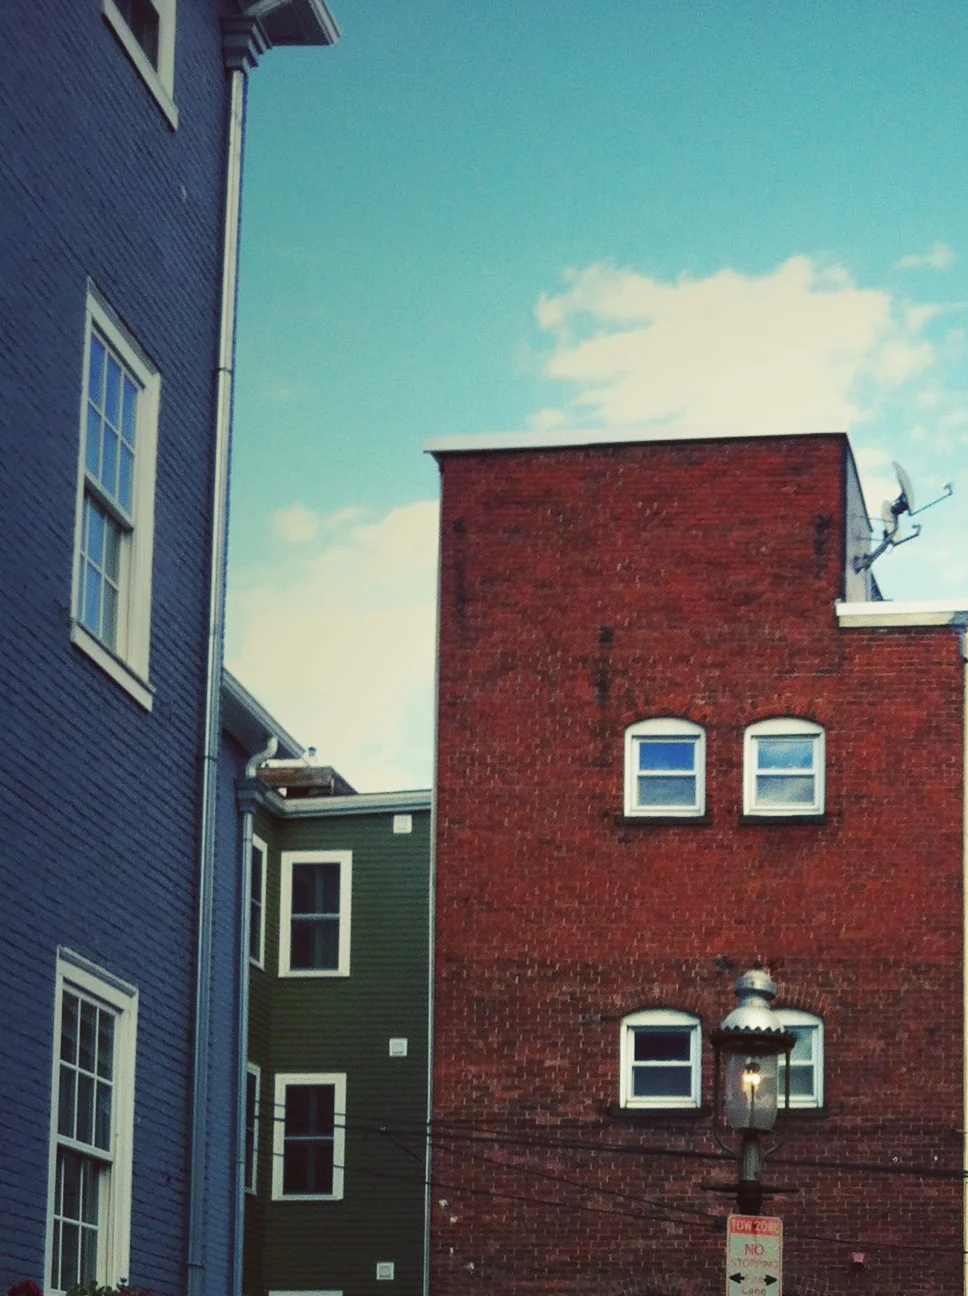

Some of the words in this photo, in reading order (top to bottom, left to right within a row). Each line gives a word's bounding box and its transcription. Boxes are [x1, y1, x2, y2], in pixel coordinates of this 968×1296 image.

[730, 1219, 752, 1231] TOW
[755, 1219, 780, 1233] ZONE
[744, 1243, 765, 1256] NO
